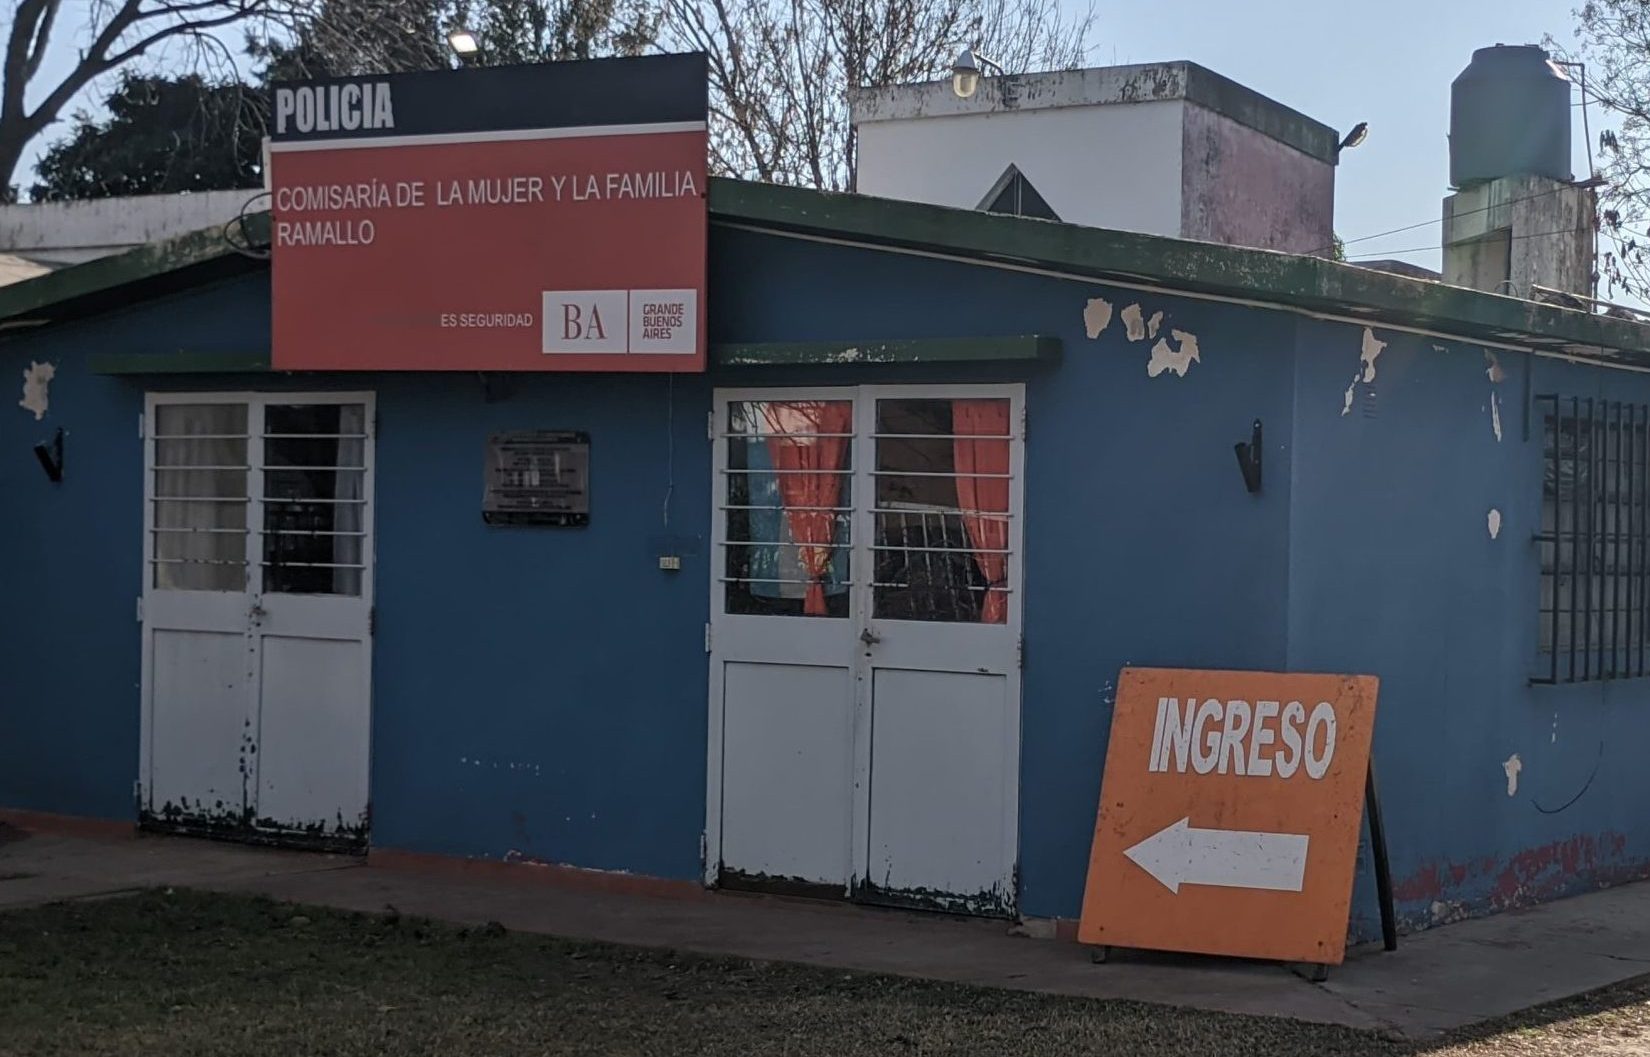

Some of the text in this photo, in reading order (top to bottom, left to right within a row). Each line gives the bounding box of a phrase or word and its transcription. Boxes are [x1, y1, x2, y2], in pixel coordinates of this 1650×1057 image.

[276, 83, 395, 134] POLICIA
[277, 171, 697, 211] COMISARÍA DE LA MUJER Y LA FAMILIA
[277, 220, 375, 247] RAMALLO
[440, 312, 534, 328] ES SEGURIDAD
[560, 302, 608, 340] BA
[643, 303, 685, 316] GRANDE
[643, 315, 683, 328] BUENOS
[642, 327, 672, 340] AIRES
[1148, 697, 1337, 780] INGRESO
